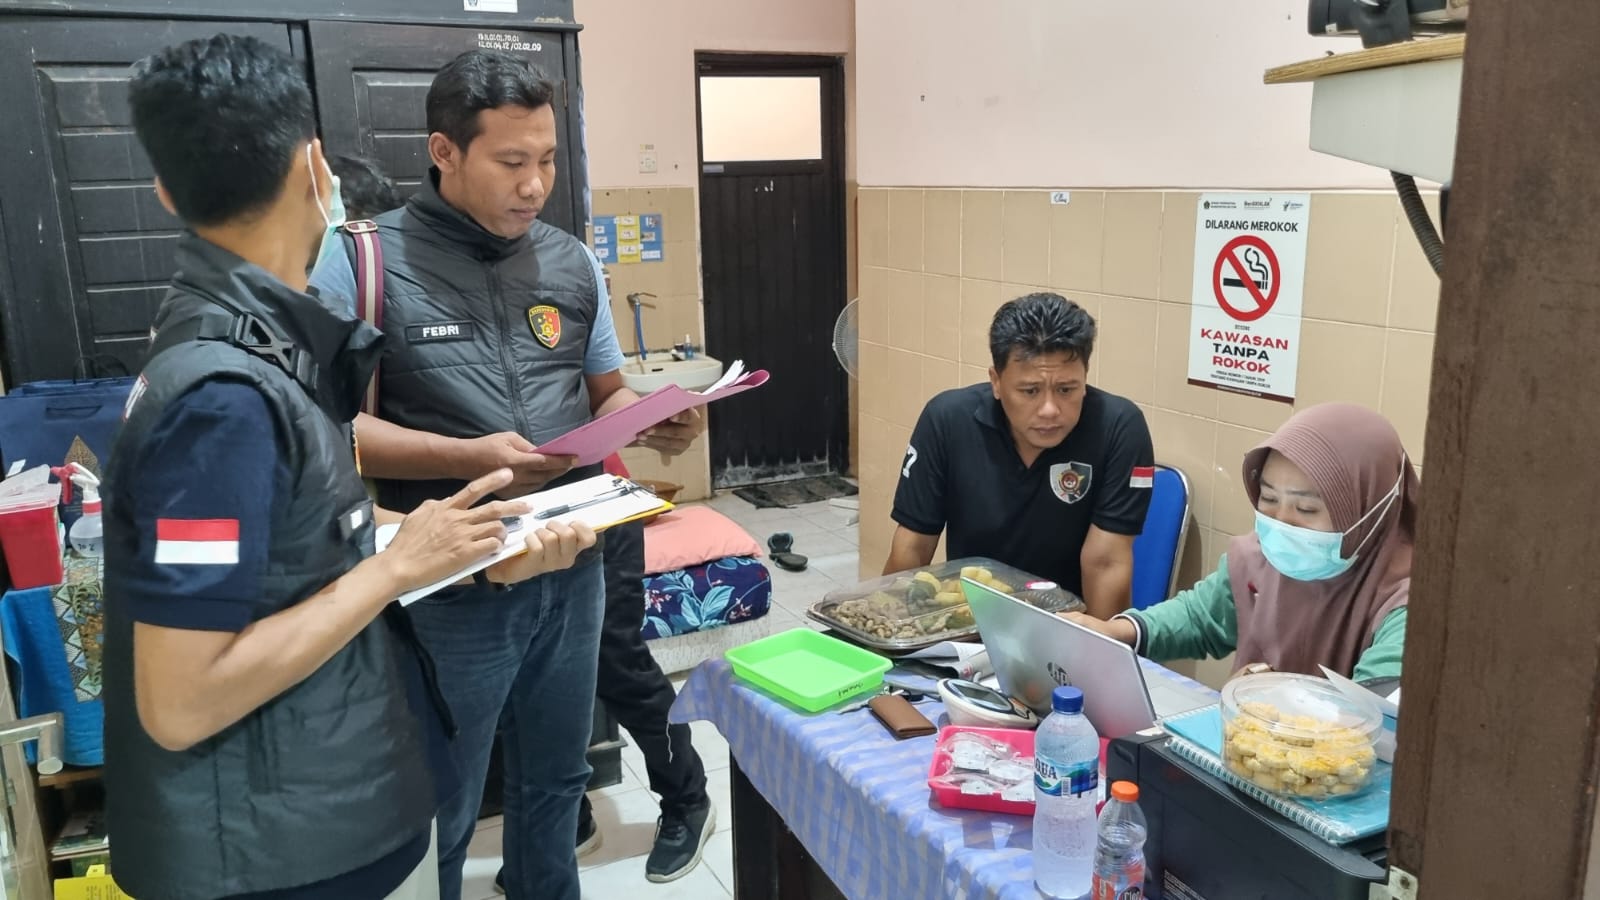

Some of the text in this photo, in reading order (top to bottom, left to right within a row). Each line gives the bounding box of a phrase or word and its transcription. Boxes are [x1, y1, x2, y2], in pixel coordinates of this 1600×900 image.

[1205, 219, 1298, 232] DILARANG MEROKOK
[423, 325, 459, 337] FEBRI
[1201, 328, 1288, 350] KAWASAN
[1213, 343, 1269, 361] TANPA
[1213, 356, 1270, 374] ROKOK
